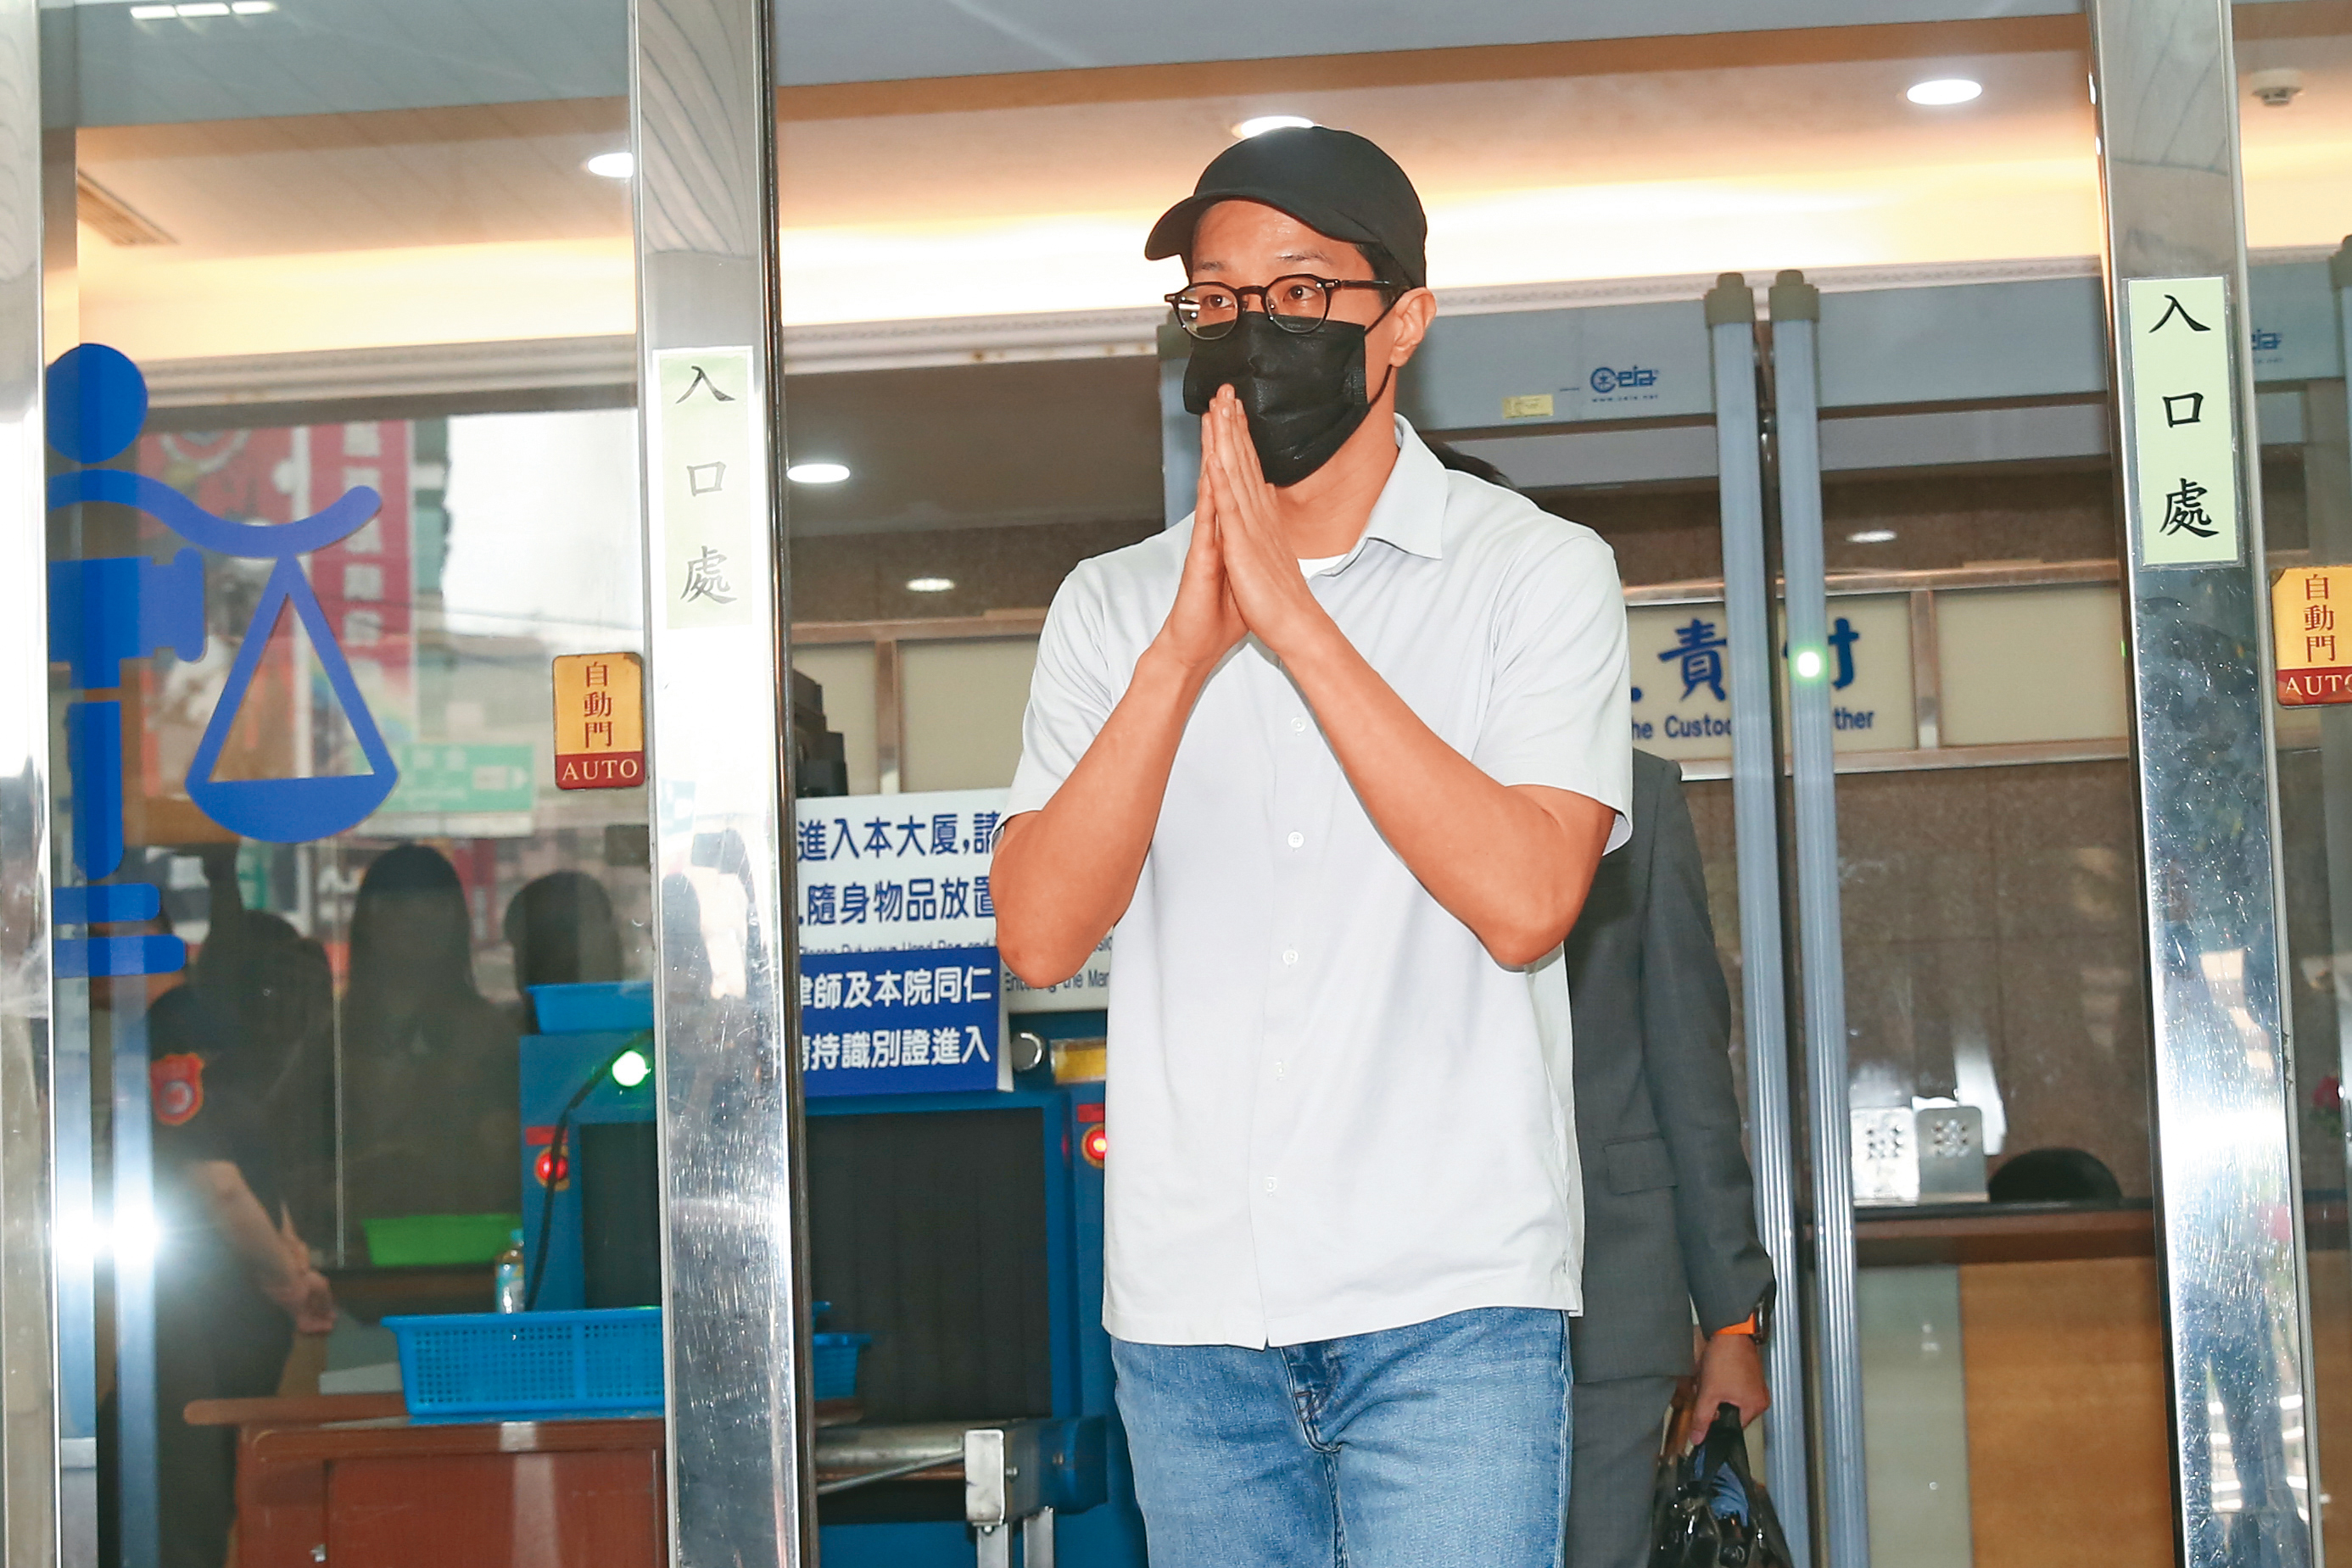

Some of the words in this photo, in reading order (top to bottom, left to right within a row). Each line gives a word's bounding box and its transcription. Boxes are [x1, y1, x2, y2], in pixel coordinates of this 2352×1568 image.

[2148, 294, 2220, 538] 入口處
[676, 365, 737, 604] 入口處
[2304, 574, 2336, 662] 自動門
[584, 661, 612, 748] 自動門
[1833, 707, 1875, 731] ther
[561, 758, 638, 781] AUTO
